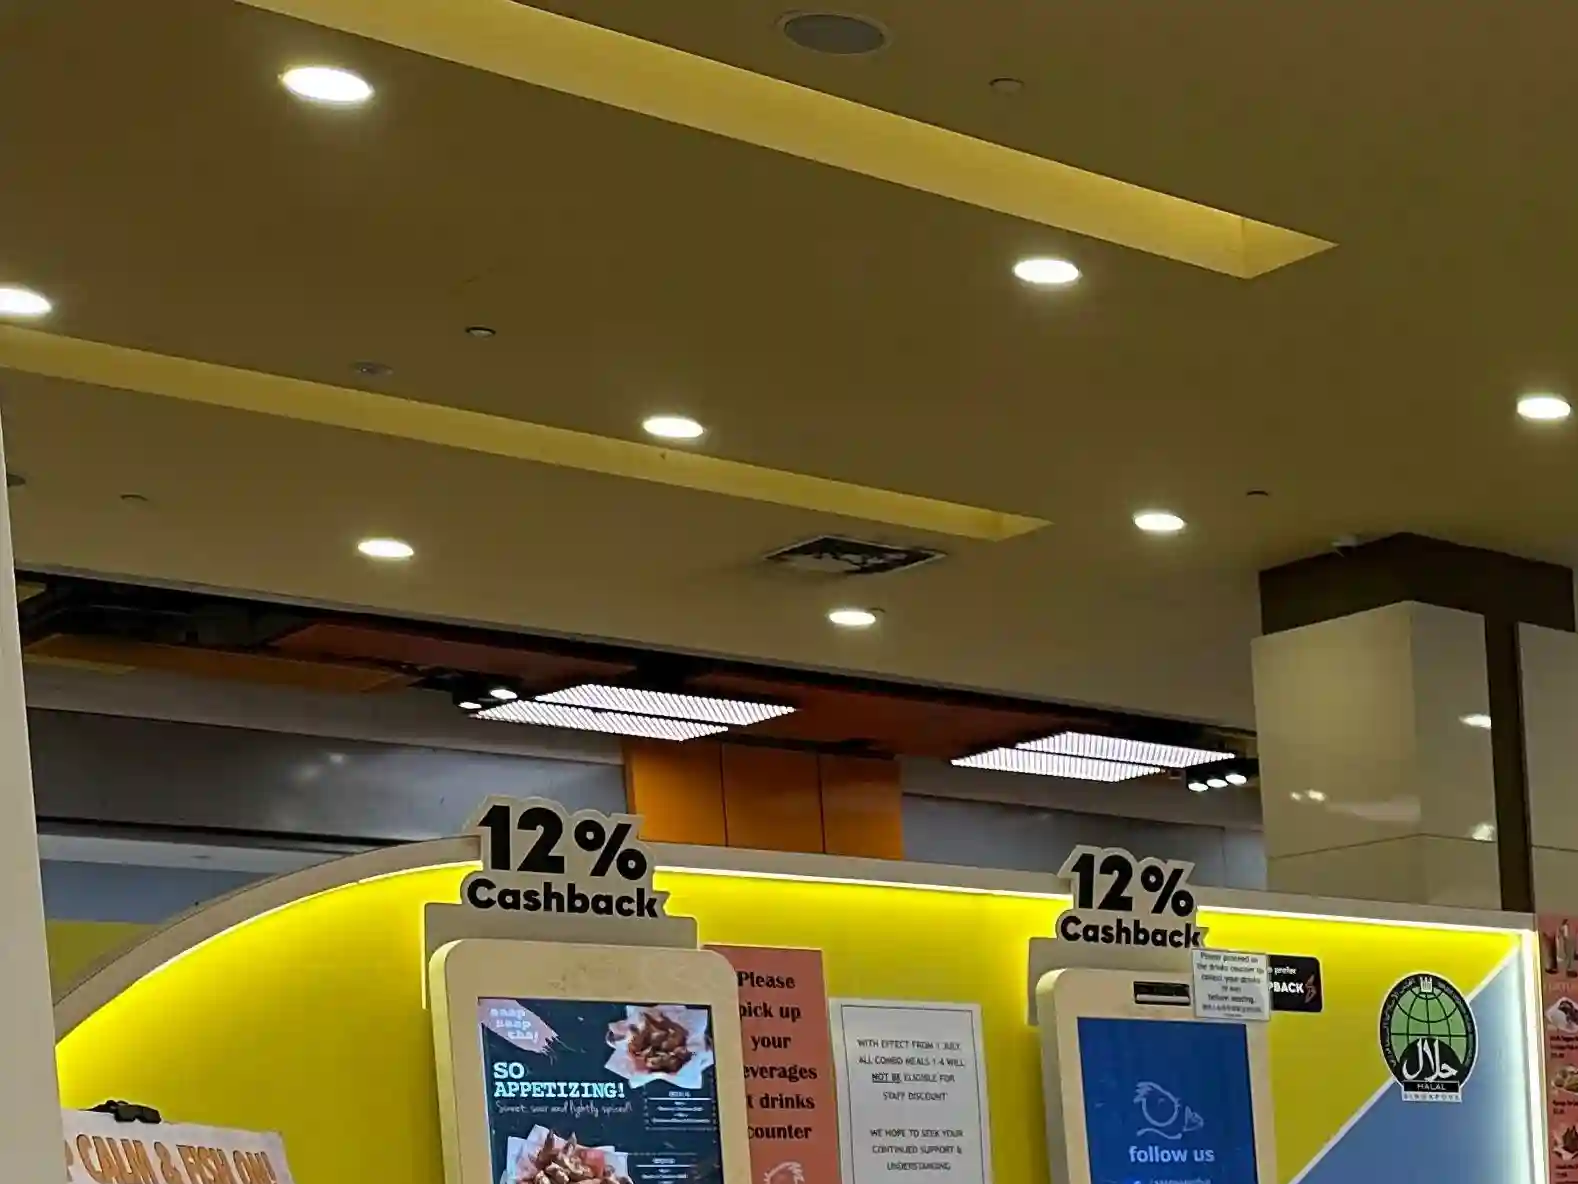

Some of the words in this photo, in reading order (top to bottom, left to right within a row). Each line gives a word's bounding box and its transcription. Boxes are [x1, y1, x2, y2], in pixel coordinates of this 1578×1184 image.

[477, 805, 648, 881] 12%
[1071, 853, 1194, 917] 12%
[467, 877, 658, 918] Cashback
[1060, 915, 1200, 948] Cashback
[738, 970, 796, 989] Please
[740, 1001, 773, 1019] pick
[780, 1004, 801, 1022] up
[751, 1035, 791, 1052] your
[859, 1056, 873, 1065] ALL
[875, 1056, 903, 1066] COMBO
[905, 1056, 930, 1066] MEALS
[947, 1058, 965, 1067] WILL
[494, 1062, 524, 1079] SO
[743, 1063, 818, 1082] everages
[872, 1072, 888, 1084] NOT
[892, 1073, 901, 1084] BE
[904, 1073, 937, 1083] ELIGIBLE
[940, 1074, 955, 1083] FOR
[494, 1082, 625, 1098] APPETIZING!
[883, 1090, 905, 1101] STAFF
[908, 1092, 948, 1101] DISCOUNT
[1416, 1082, 1446, 1092] HALAL
[760, 1092, 815, 1110] drinks
[747, 1124, 812, 1140] counter
[870, 1128, 882, 1138] WE
[885, 1128, 905, 1138] HOPE
[908, 1129, 919, 1138] TO
[921, 1129, 938, 1138] SEEK
[940, 1129, 963, 1138] YOUR
[872, 1145, 917, 1155] CONTINUED
[920, 1146, 952, 1155] SUPPORT
[1129, 1146, 1187, 1163] follow
[1193, 1149, 1215, 1162] us
[887, 1162, 951, 1171] UNDERSTANDING
